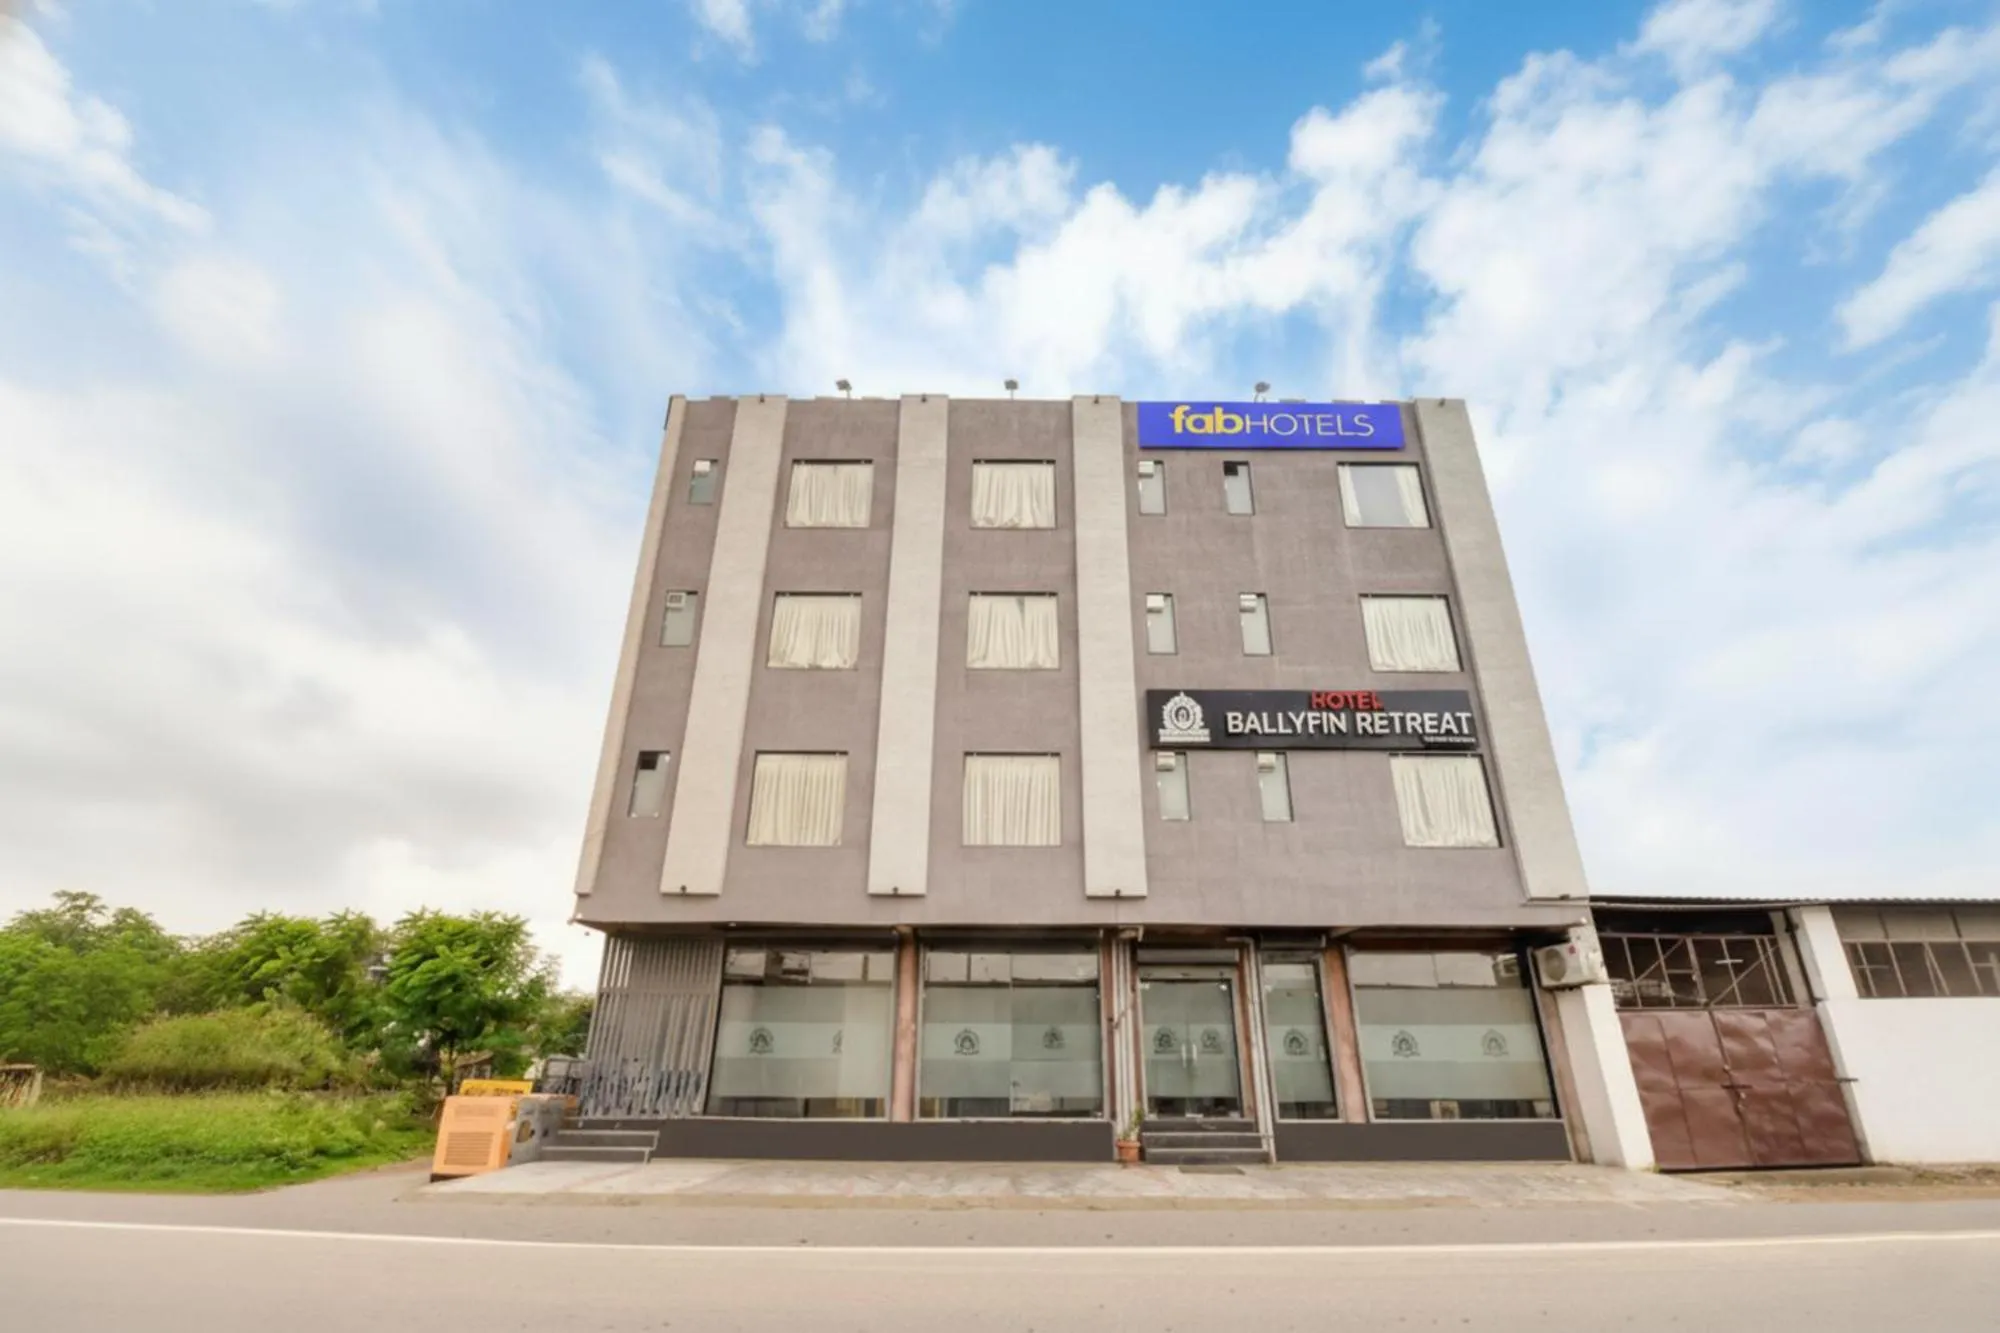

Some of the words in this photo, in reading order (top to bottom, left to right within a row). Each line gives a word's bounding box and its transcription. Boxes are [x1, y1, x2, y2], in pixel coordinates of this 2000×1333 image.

[1169, 405, 1374, 436] fabHOTELS
[1310, 689, 1384, 710] HOTEL
[1226, 711, 1348, 734] BALLYFIN
[1355, 711, 1473, 735] RETREAT
